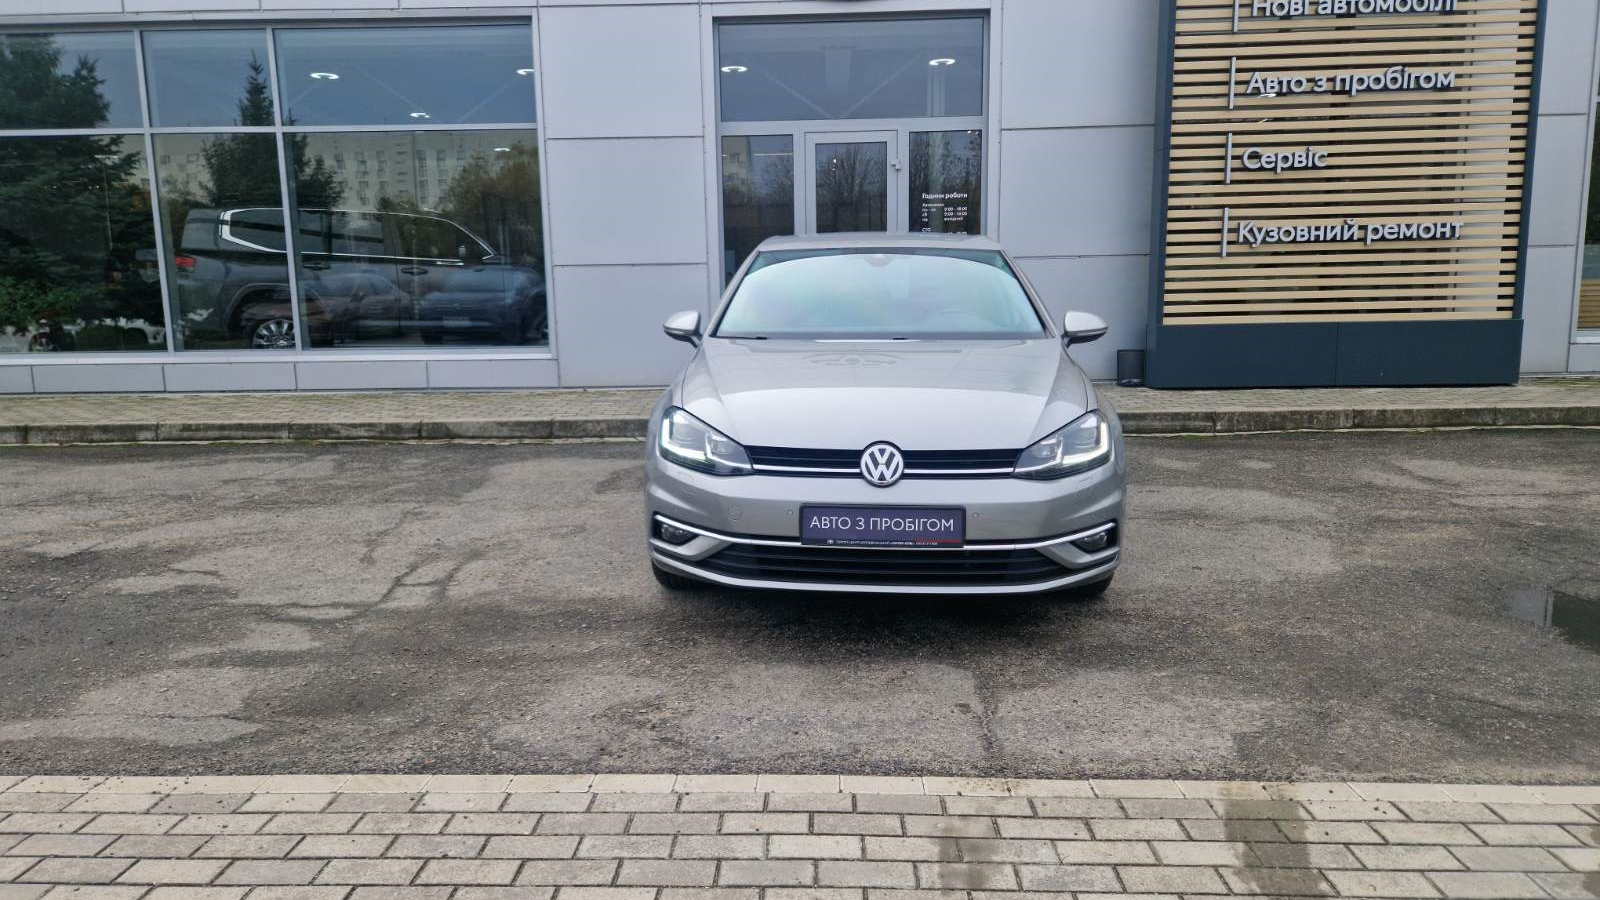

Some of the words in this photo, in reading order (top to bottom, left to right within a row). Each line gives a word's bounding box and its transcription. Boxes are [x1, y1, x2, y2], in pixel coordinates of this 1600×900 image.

[1246, 71, 1307, 94] Авто
[1314, 76, 1326, 93] з
[1335, 65, 1456, 96] пробігом
[1241, 146, 1329, 173] Сервіс
[1237, 219, 1360, 248] Кузовний
[1366, 220, 1463, 245] ремонт
[810, 516, 851, 530] АВТО
[856, 517, 865, 530] З
[870, 517, 954, 531] ПРОБІГОМ
